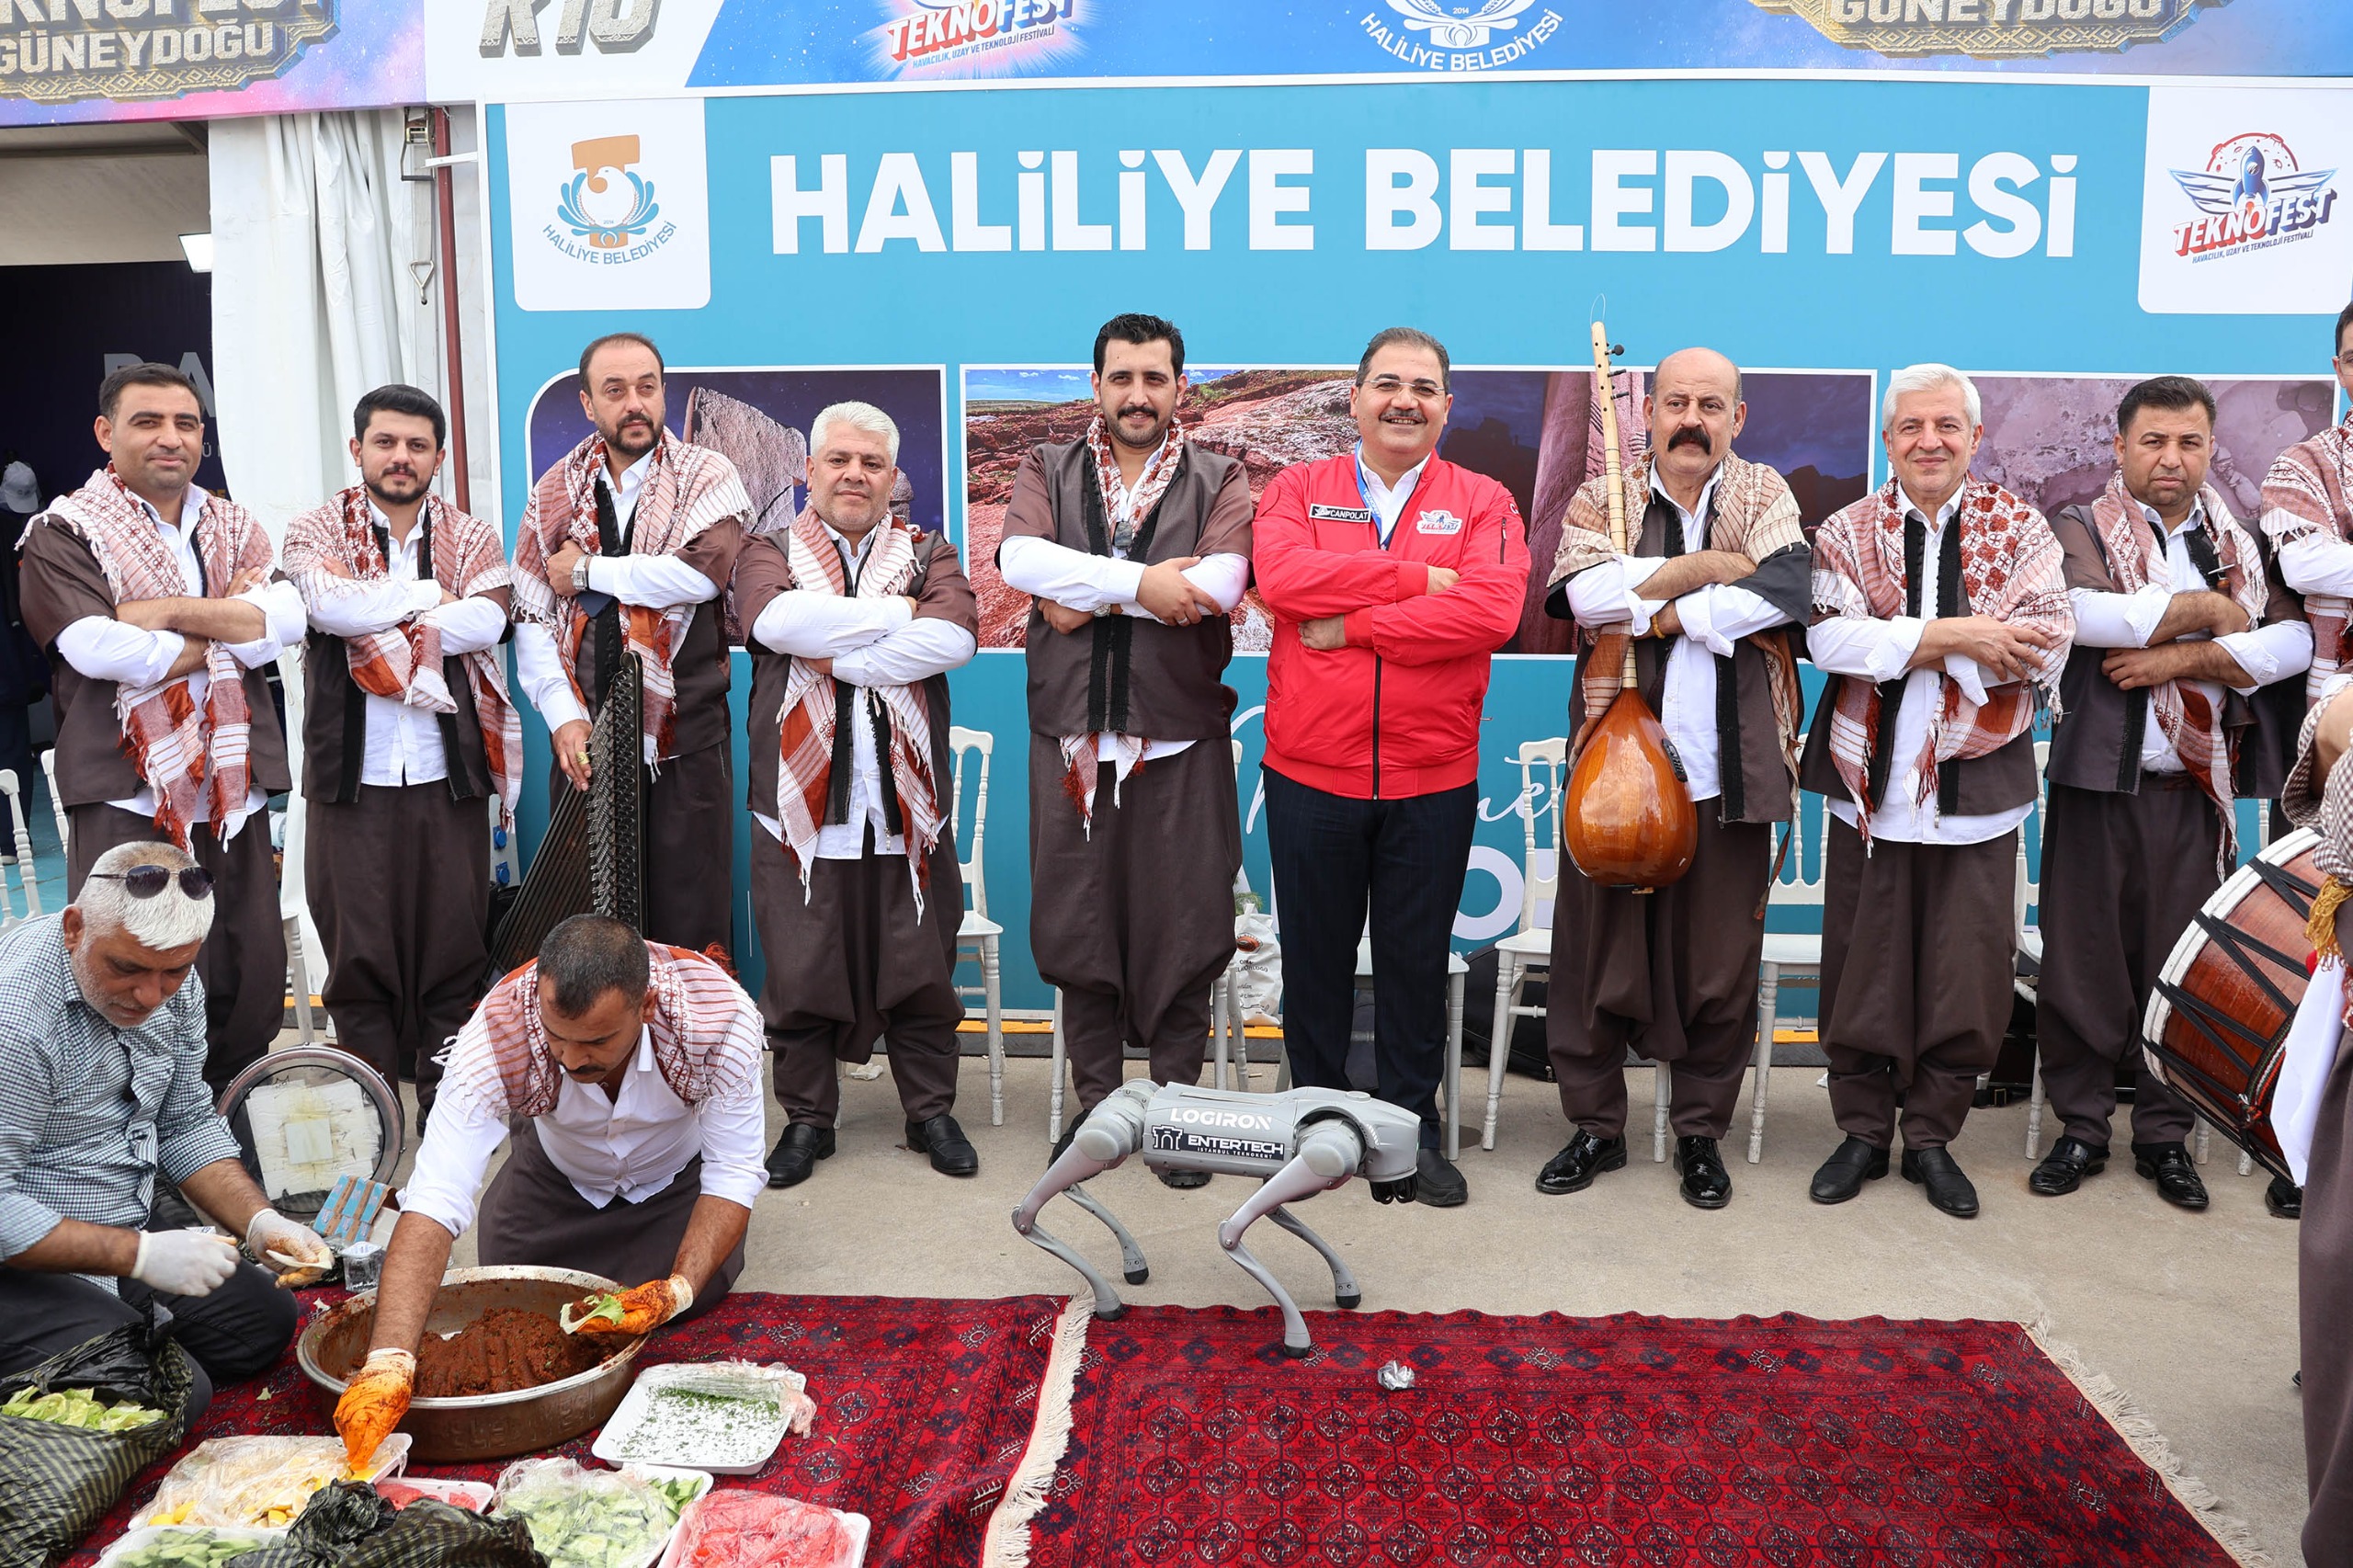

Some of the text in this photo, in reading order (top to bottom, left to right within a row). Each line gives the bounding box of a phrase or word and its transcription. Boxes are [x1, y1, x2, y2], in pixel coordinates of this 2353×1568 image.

[1452, 6, 1470, 15] 2014
[0, 18, 275, 75] GÜNEYDOĞU
[913, 24, 1055, 69] HAVACILIK, UZAY VE TEKNOLOJİ FESTİVALİ
[1359, 8, 1563, 72] HALİLİYE BELEDİYESİ
[2173, 187, 2337, 257] TEKNOFEST
[542, 220, 677, 265] HALİLİYE BELEDİYESİ
[2226, 246, 2241, 256] UZAY
[2242, 244, 2251, 253] VE
[2251, 235, 2283, 251] TEKNOLOJİ
[2283, 229, 2314, 244] FESTİVALİ
[1330, 509, 1369, 520] CANPOLAT
[1169, 1108, 1273, 1131] LOGIRON
[1188, 1134, 1284, 1155] ENTERTECH
[1233, 1151, 1273, 1159] TEKNOKENT
